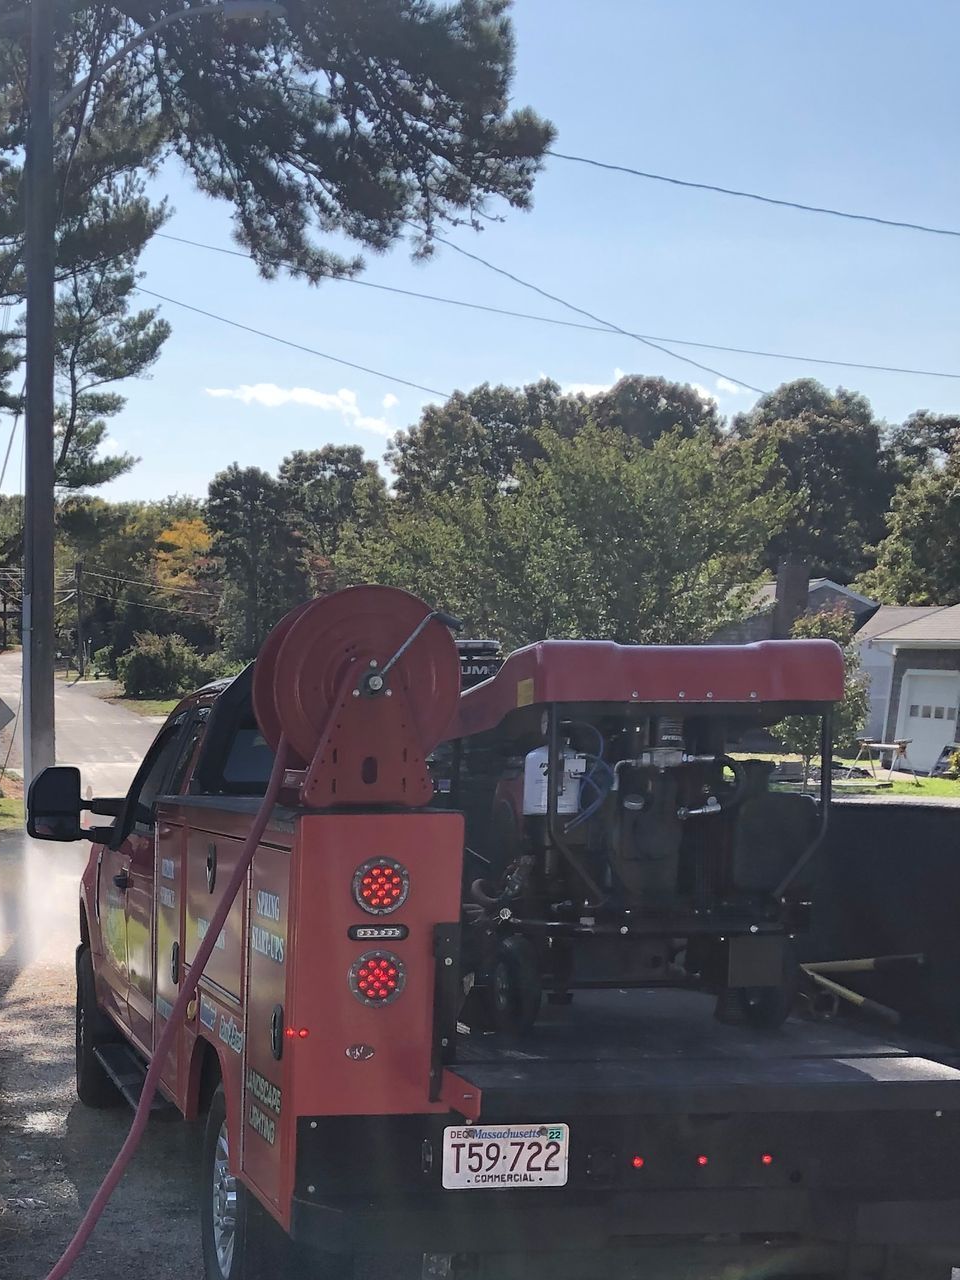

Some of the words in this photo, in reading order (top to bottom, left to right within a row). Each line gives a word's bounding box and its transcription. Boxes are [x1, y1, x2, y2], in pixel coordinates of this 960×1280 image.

[257, 889, 280, 921] SPRING
[252, 926, 284, 962] START-UPS
[245, 1068, 281, 1114] LANDSCAPE
[249, 1103, 276, 1145] LIGHTING
[473, 1128, 541, 1140] Massachusetts
[548, 1131, 561, 1140] 22
[474, 1174, 535, 1183] COMMERCIAL
